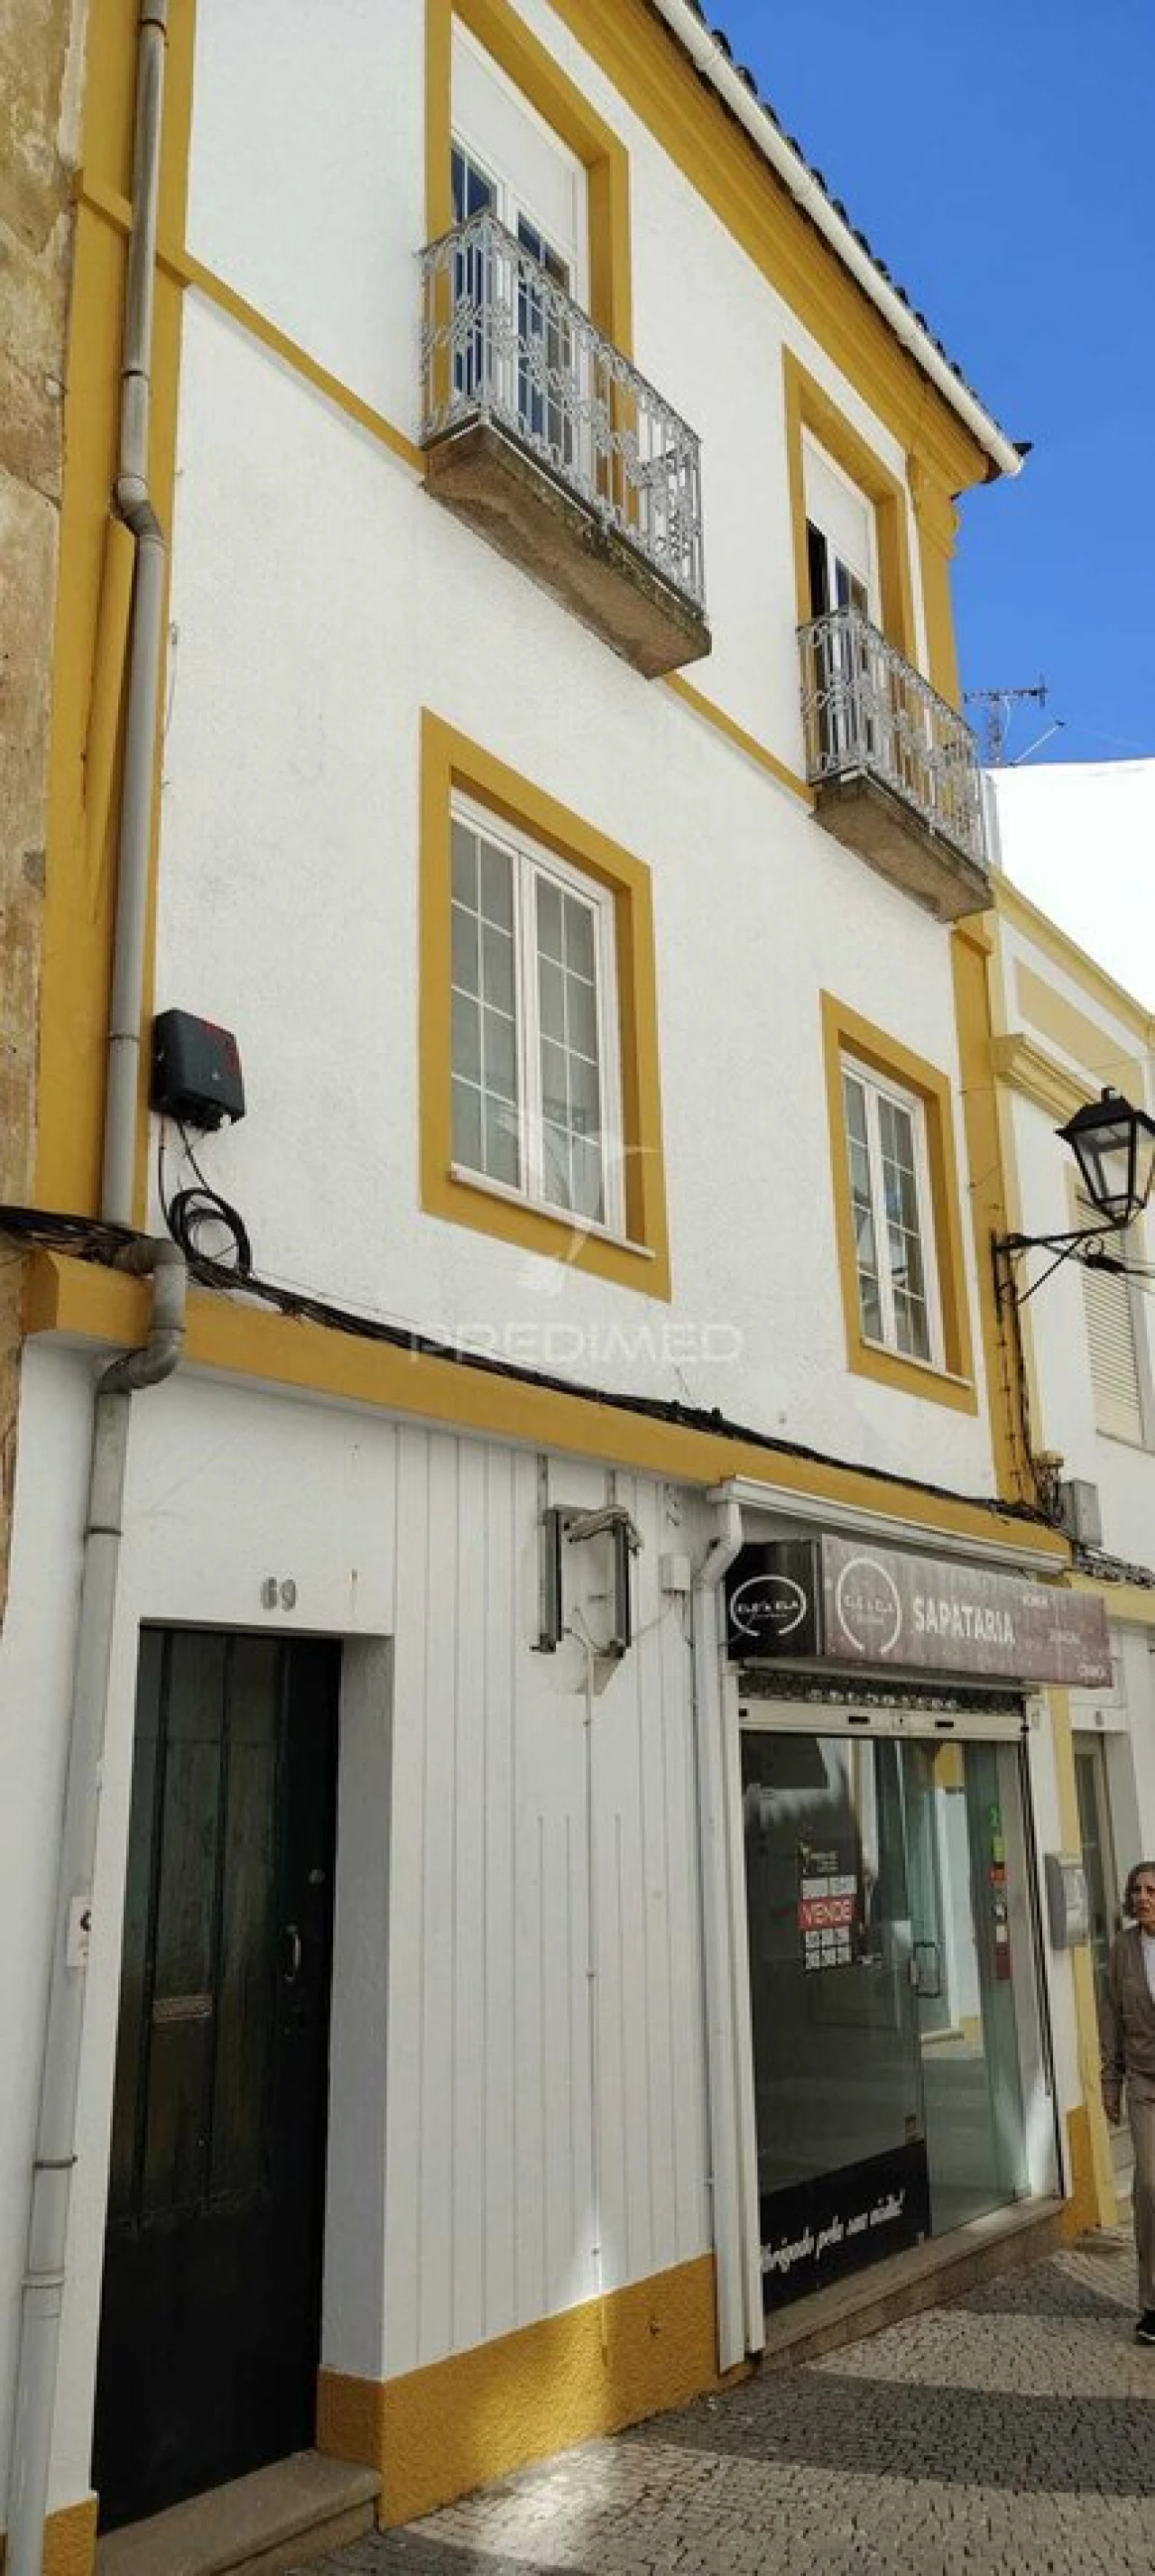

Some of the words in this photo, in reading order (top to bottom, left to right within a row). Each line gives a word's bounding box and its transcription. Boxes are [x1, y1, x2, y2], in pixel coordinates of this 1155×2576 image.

[261, 1576, 297, 1611] 69
[911, 1596, 1016, 1646] SAPATARIA
[801, 1897, 853, 1925] VENDE
